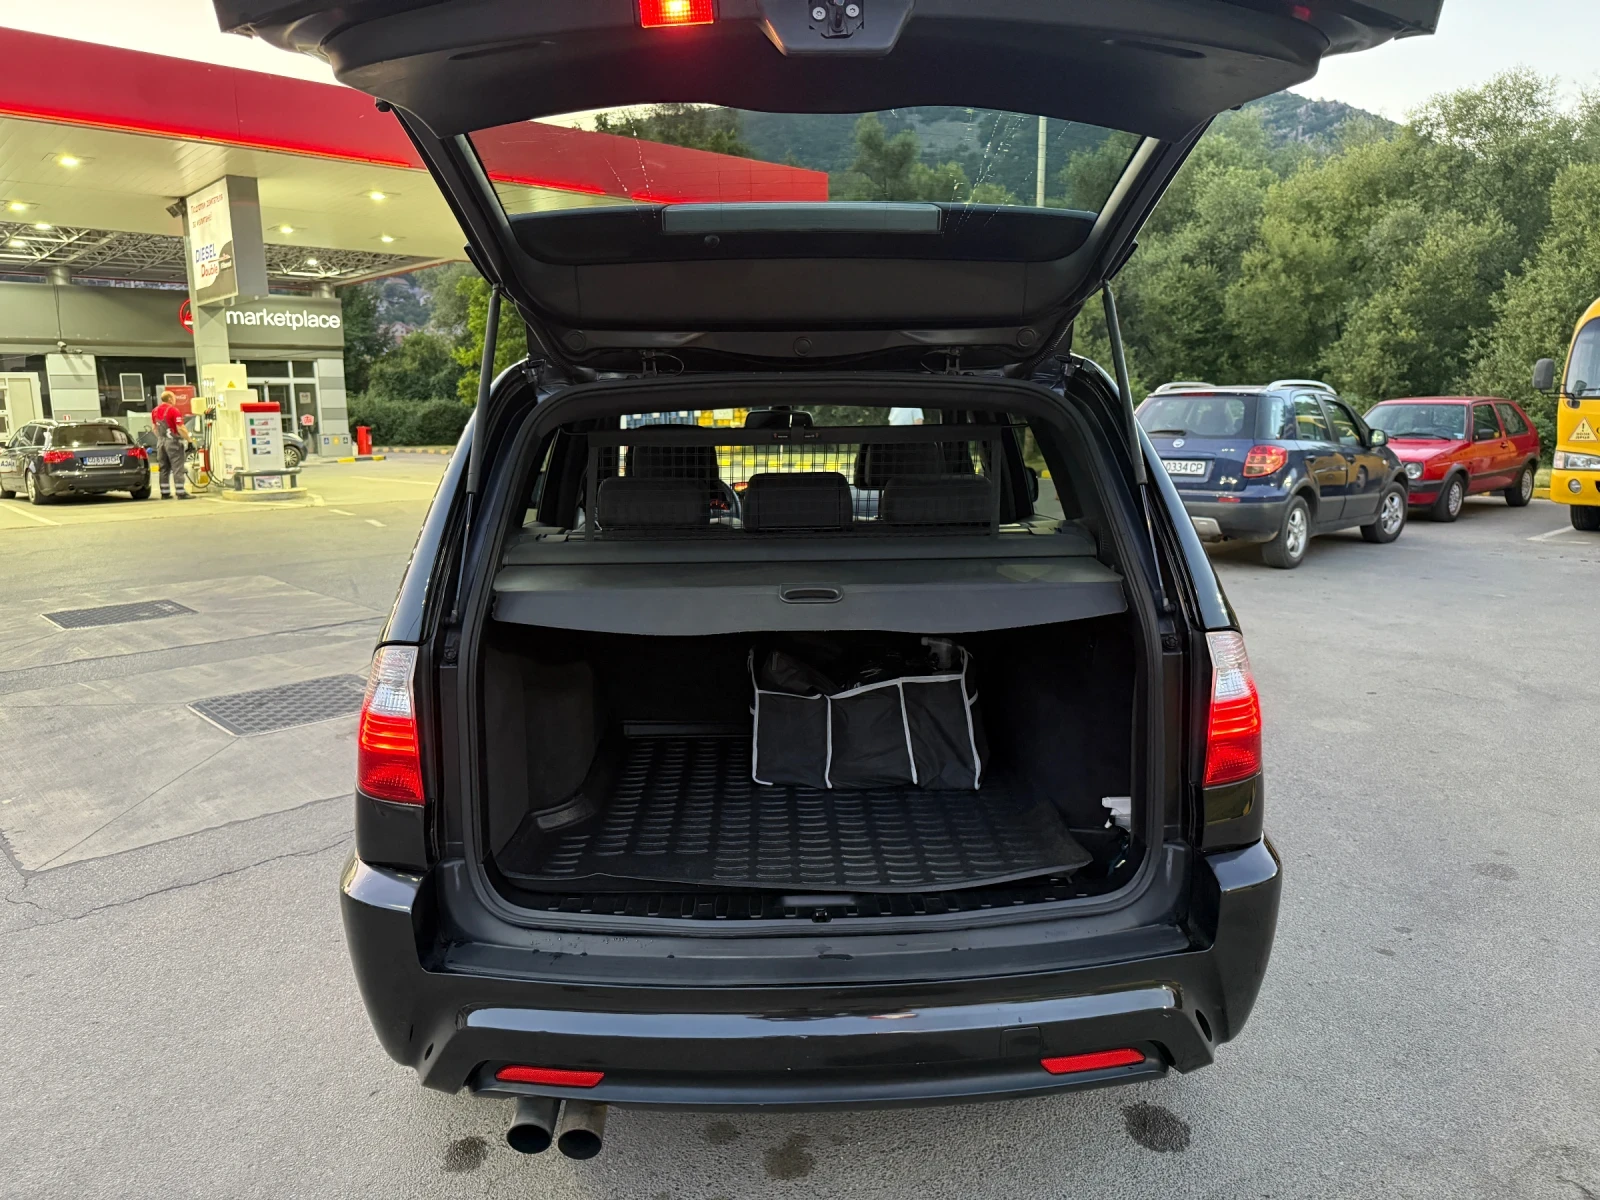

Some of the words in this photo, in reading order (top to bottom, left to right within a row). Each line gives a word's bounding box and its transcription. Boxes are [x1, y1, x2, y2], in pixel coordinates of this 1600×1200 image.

[195, 243, 217, 263] DIESEL
[201, 263, 218, 278] Double
[226, 308, 341, 331] marketplace
[1165, 462, 1188, 472] 0334
[1189, 462, 1203, 473] CP
